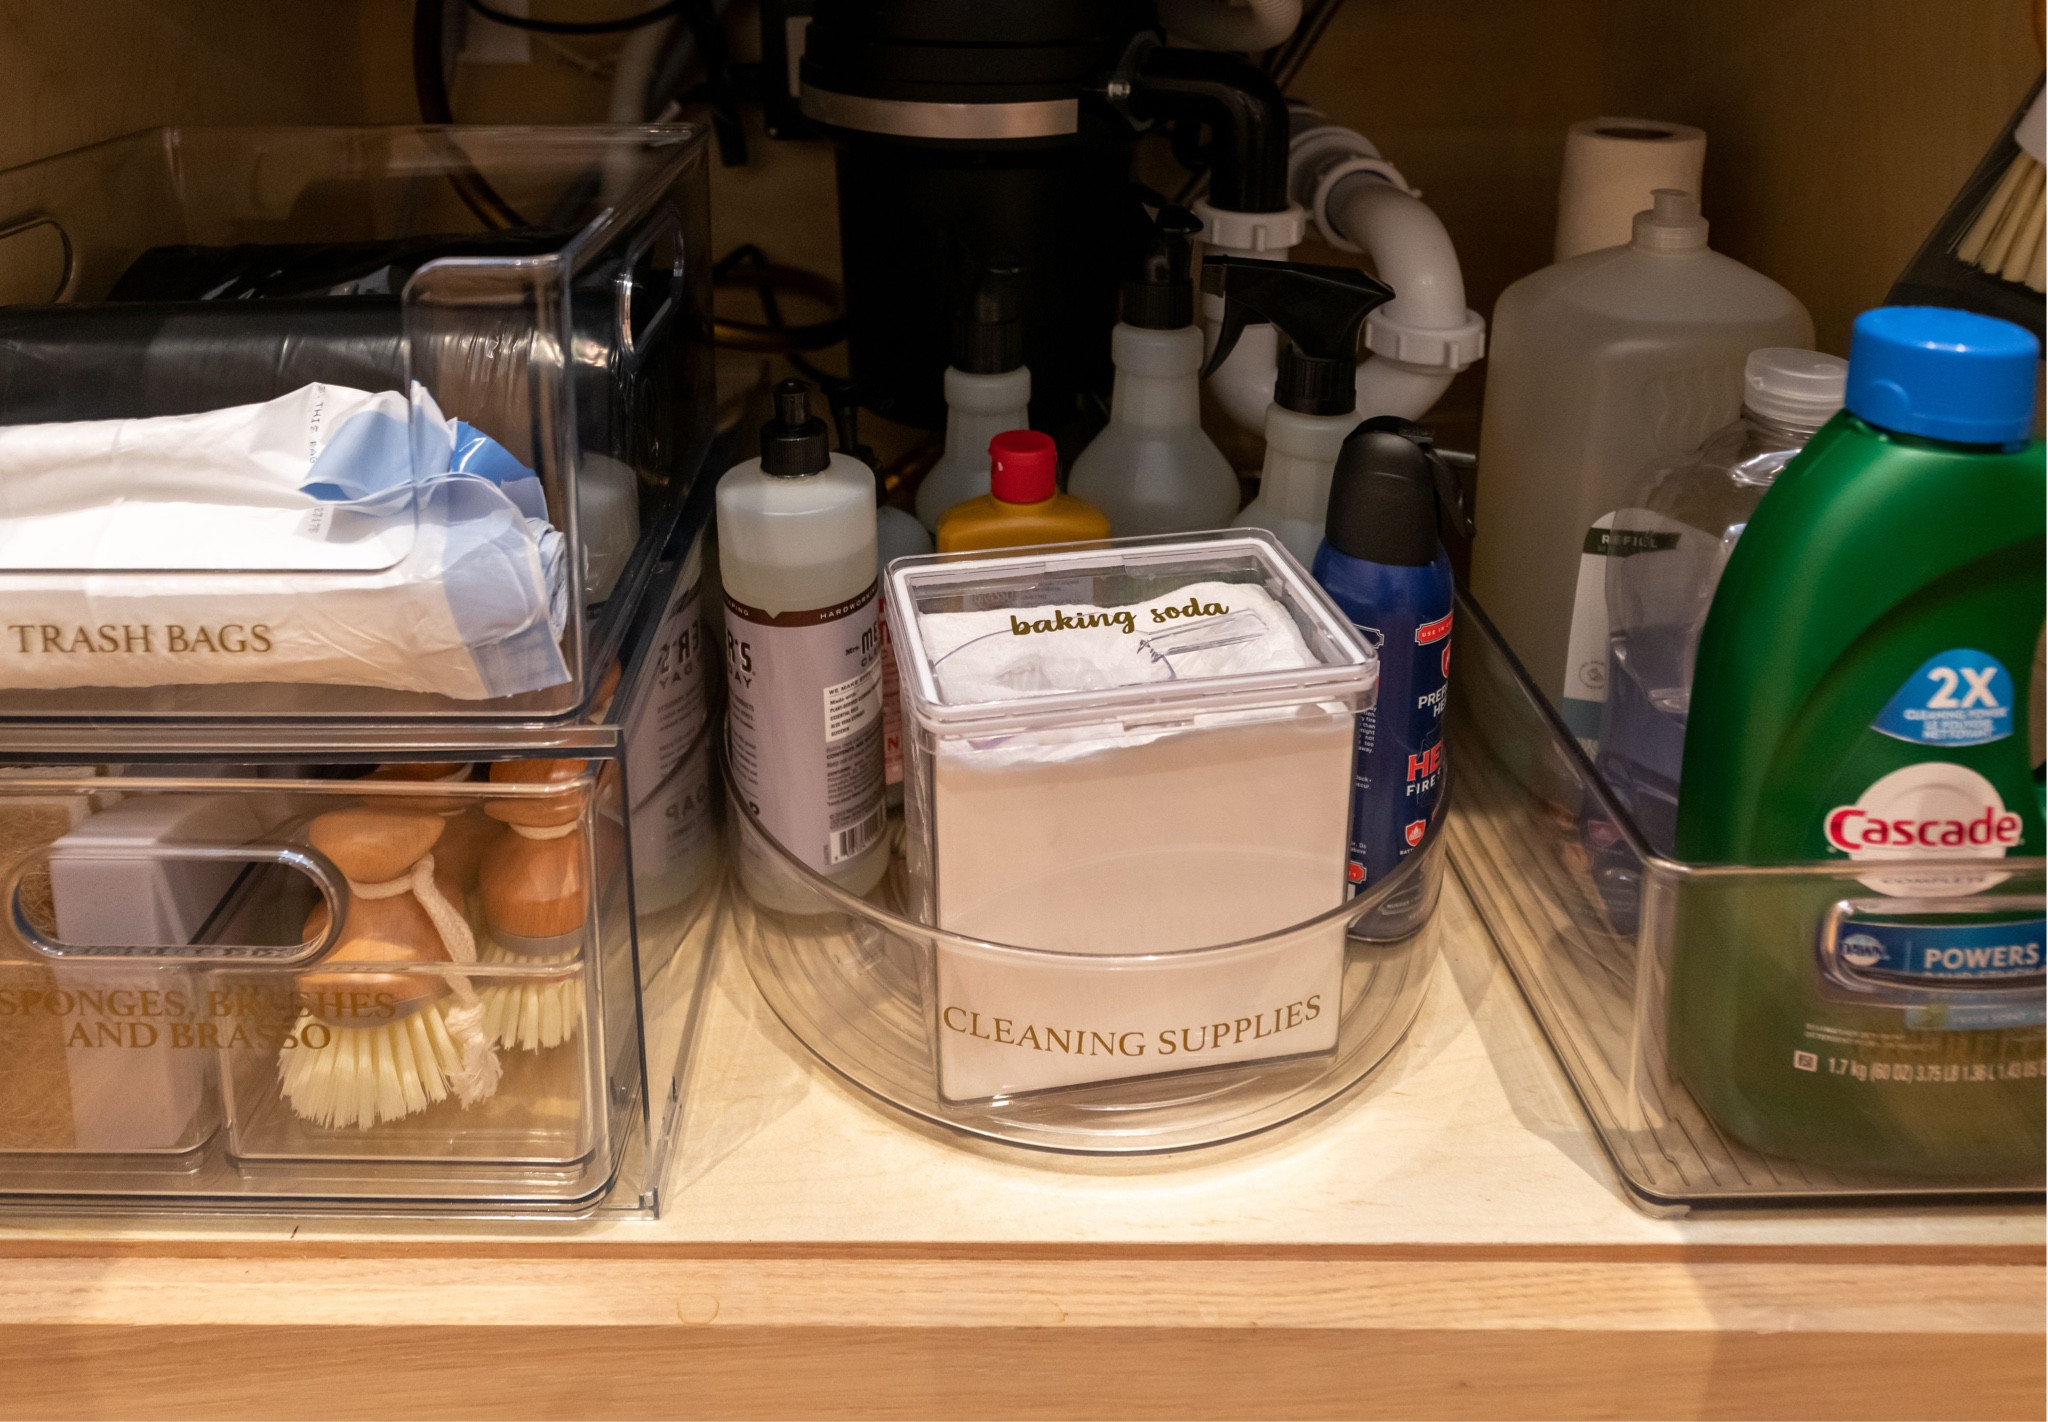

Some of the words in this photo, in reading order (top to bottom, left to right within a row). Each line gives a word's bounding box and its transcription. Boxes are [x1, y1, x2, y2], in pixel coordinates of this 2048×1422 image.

[1010, 609, 1137, 636] baking
[1150, 597, 1230, 624] soda
[8, 624, 152, 653] TRASH
[165, 624, 272, 653] BAGS
[1421, 629, 1436, 638] USE
[1926, 666, 1999, 708] 2X
[1406, 773, 1437, 797] FIRE
[1829, 806, 2018, 851] Cascade
[1923, 942, 2040, 970] POWERS
[0, 988, 197, 1022] SPONGES,
[207, 990, 397, 1019] BRSHES
[66, 1022, 158, 1049] AND
[169, 1022, 331, 1050] BRASSO
[943, 1005, 1146, 1057] CLEANING
[1157, 994, 1322, 1055] SUPPLIES
[1828, 1056, 1849, 1076] 1.7
[1851, 1059, 1868, 1082] kg
